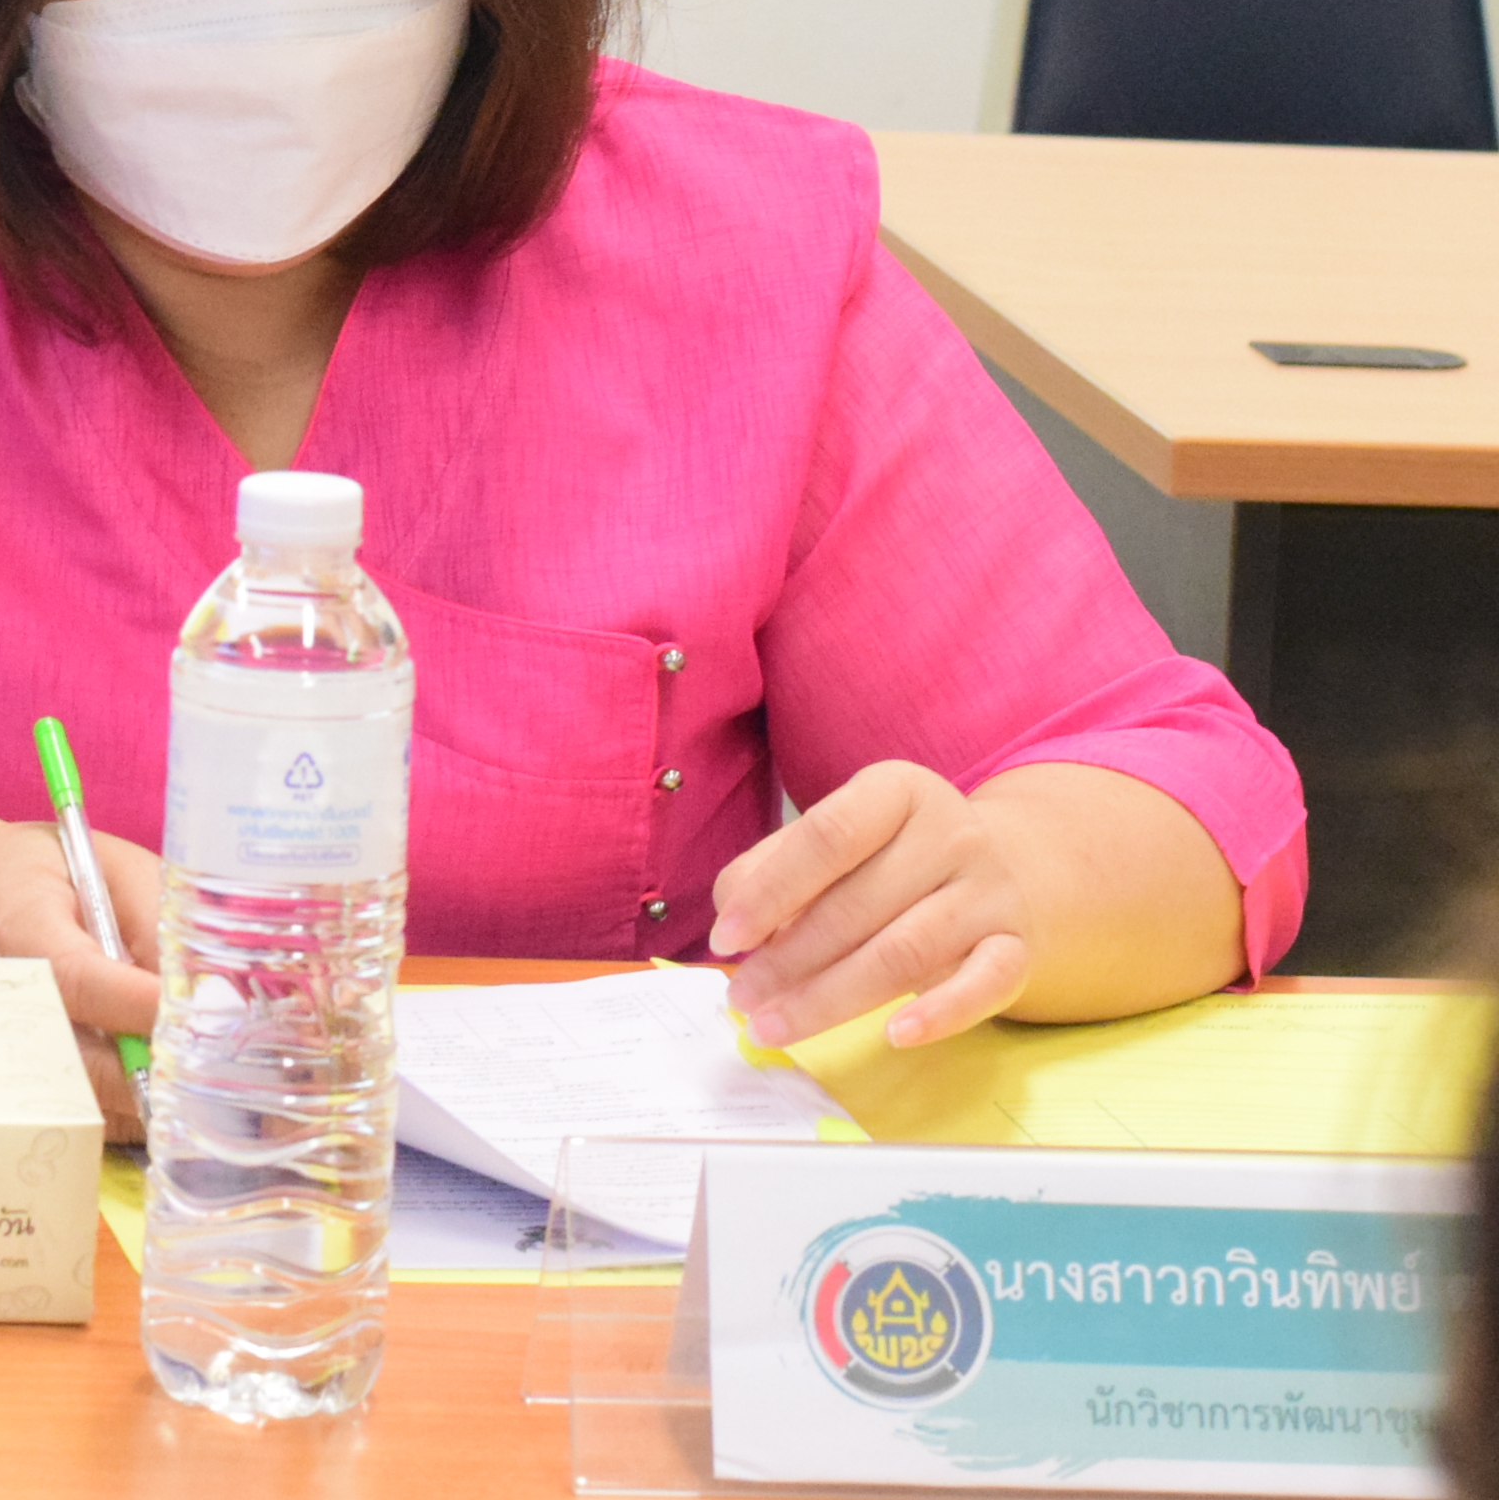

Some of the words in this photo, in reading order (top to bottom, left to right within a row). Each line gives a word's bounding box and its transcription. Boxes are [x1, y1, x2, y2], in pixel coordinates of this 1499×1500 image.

[984, 1247, 1423, 1314] นางสาวกวินทิพย์
